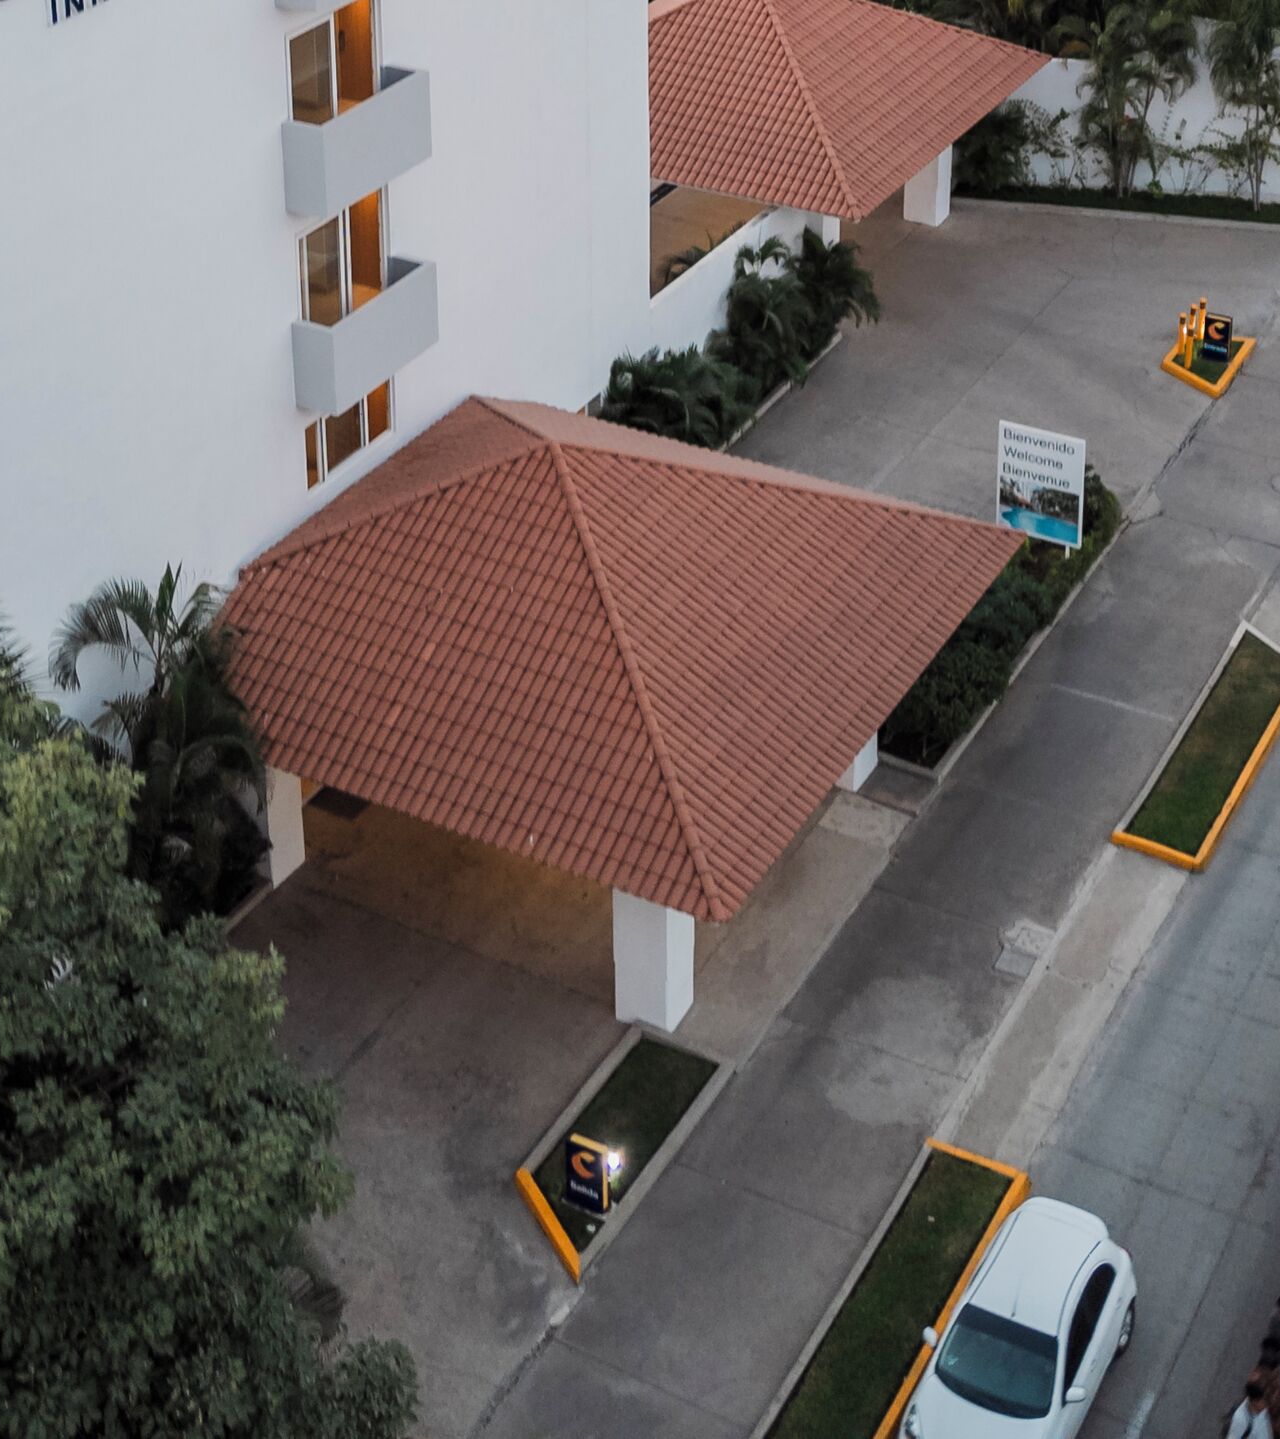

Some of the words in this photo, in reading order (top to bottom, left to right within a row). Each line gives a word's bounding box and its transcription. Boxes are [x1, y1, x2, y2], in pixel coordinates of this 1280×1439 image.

[1003, 427, 1076, 456] Bienvenido
[1003, 445, 1064, 471] Welcome
[1002, 461, 1071, 489] Bienvenue
